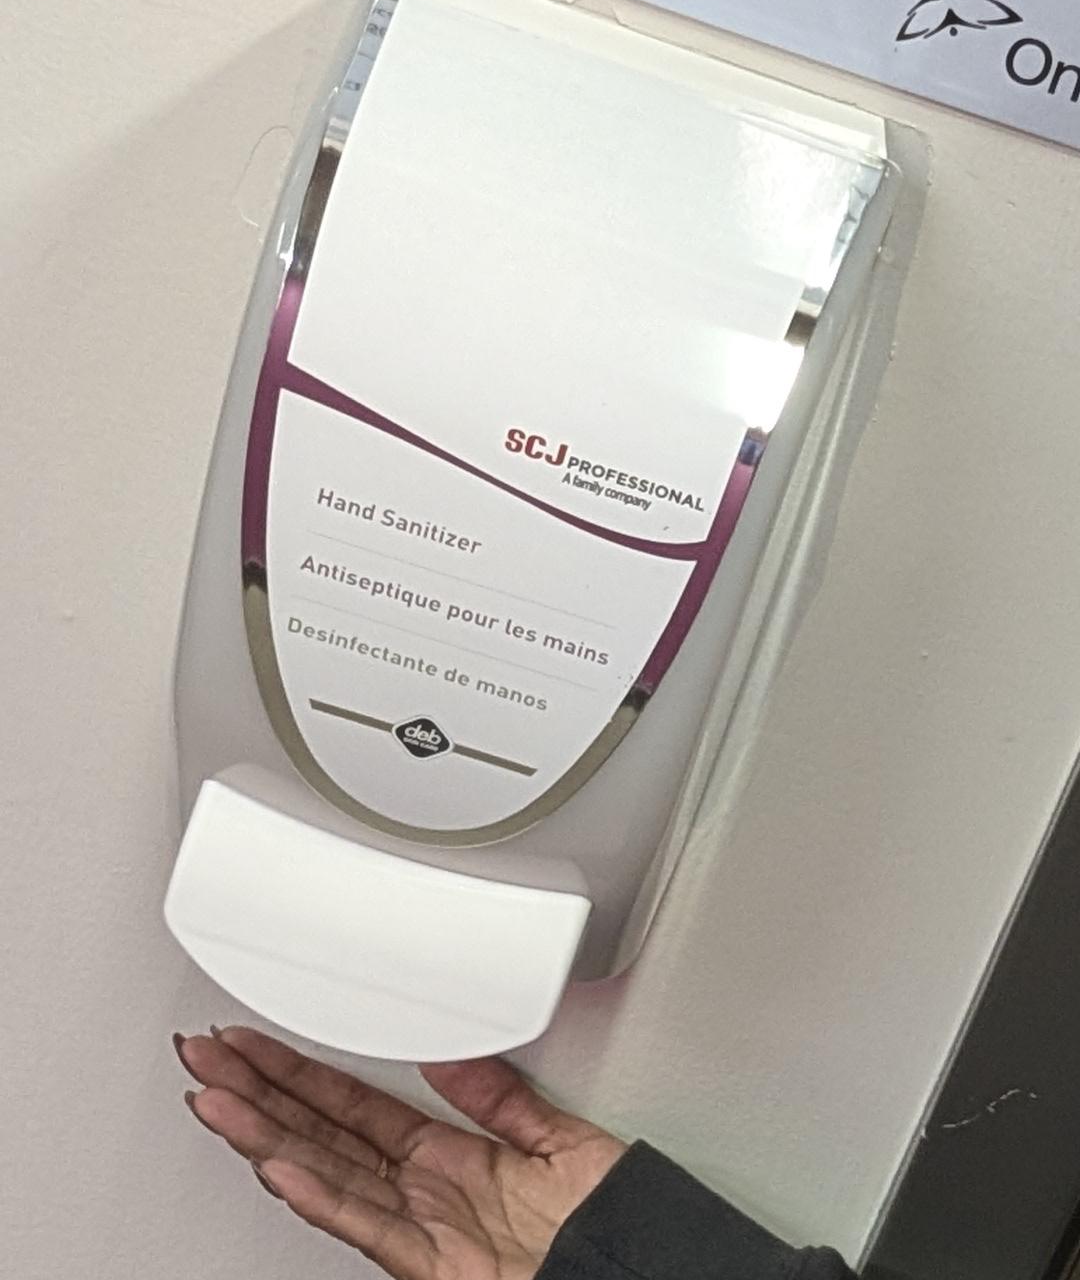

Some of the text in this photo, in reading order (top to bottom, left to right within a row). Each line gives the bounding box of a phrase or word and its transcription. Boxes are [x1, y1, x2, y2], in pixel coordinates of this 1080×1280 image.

[505, 428, 705, 512] SCJ PROFESSIONAL
[316, 487, 483, 554] Hand Sanitizer
[299, 555, 609, 666] Antiseptique pour les mains
[287, 616, 547, 711] Desinfectante de manos
[404, 724, 442, 745] deb
